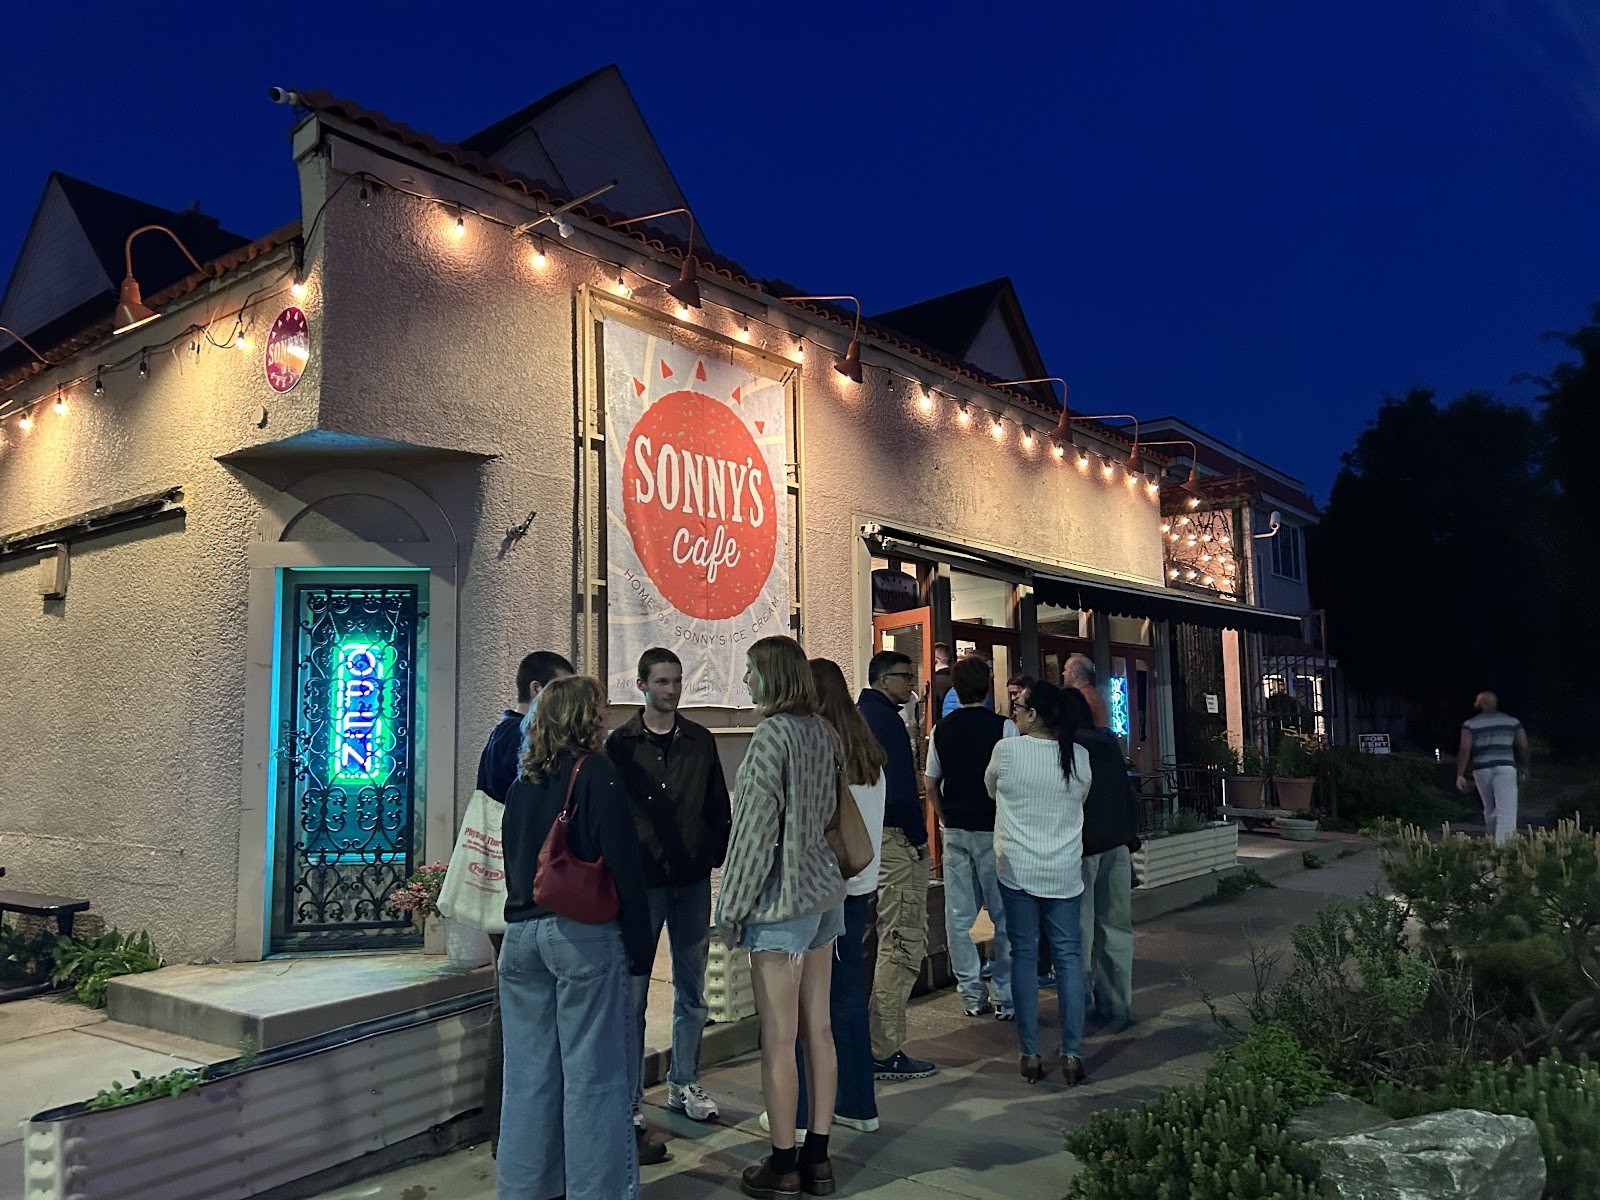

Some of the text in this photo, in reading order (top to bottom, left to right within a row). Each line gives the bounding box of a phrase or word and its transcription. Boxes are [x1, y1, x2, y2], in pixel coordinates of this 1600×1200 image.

[634, 434, 764, 528] SONNY'S
[623, 568, 779, 646] HOME OF SONNY'S ICE CREAM
[341, 648, 376, 772] OPEN
